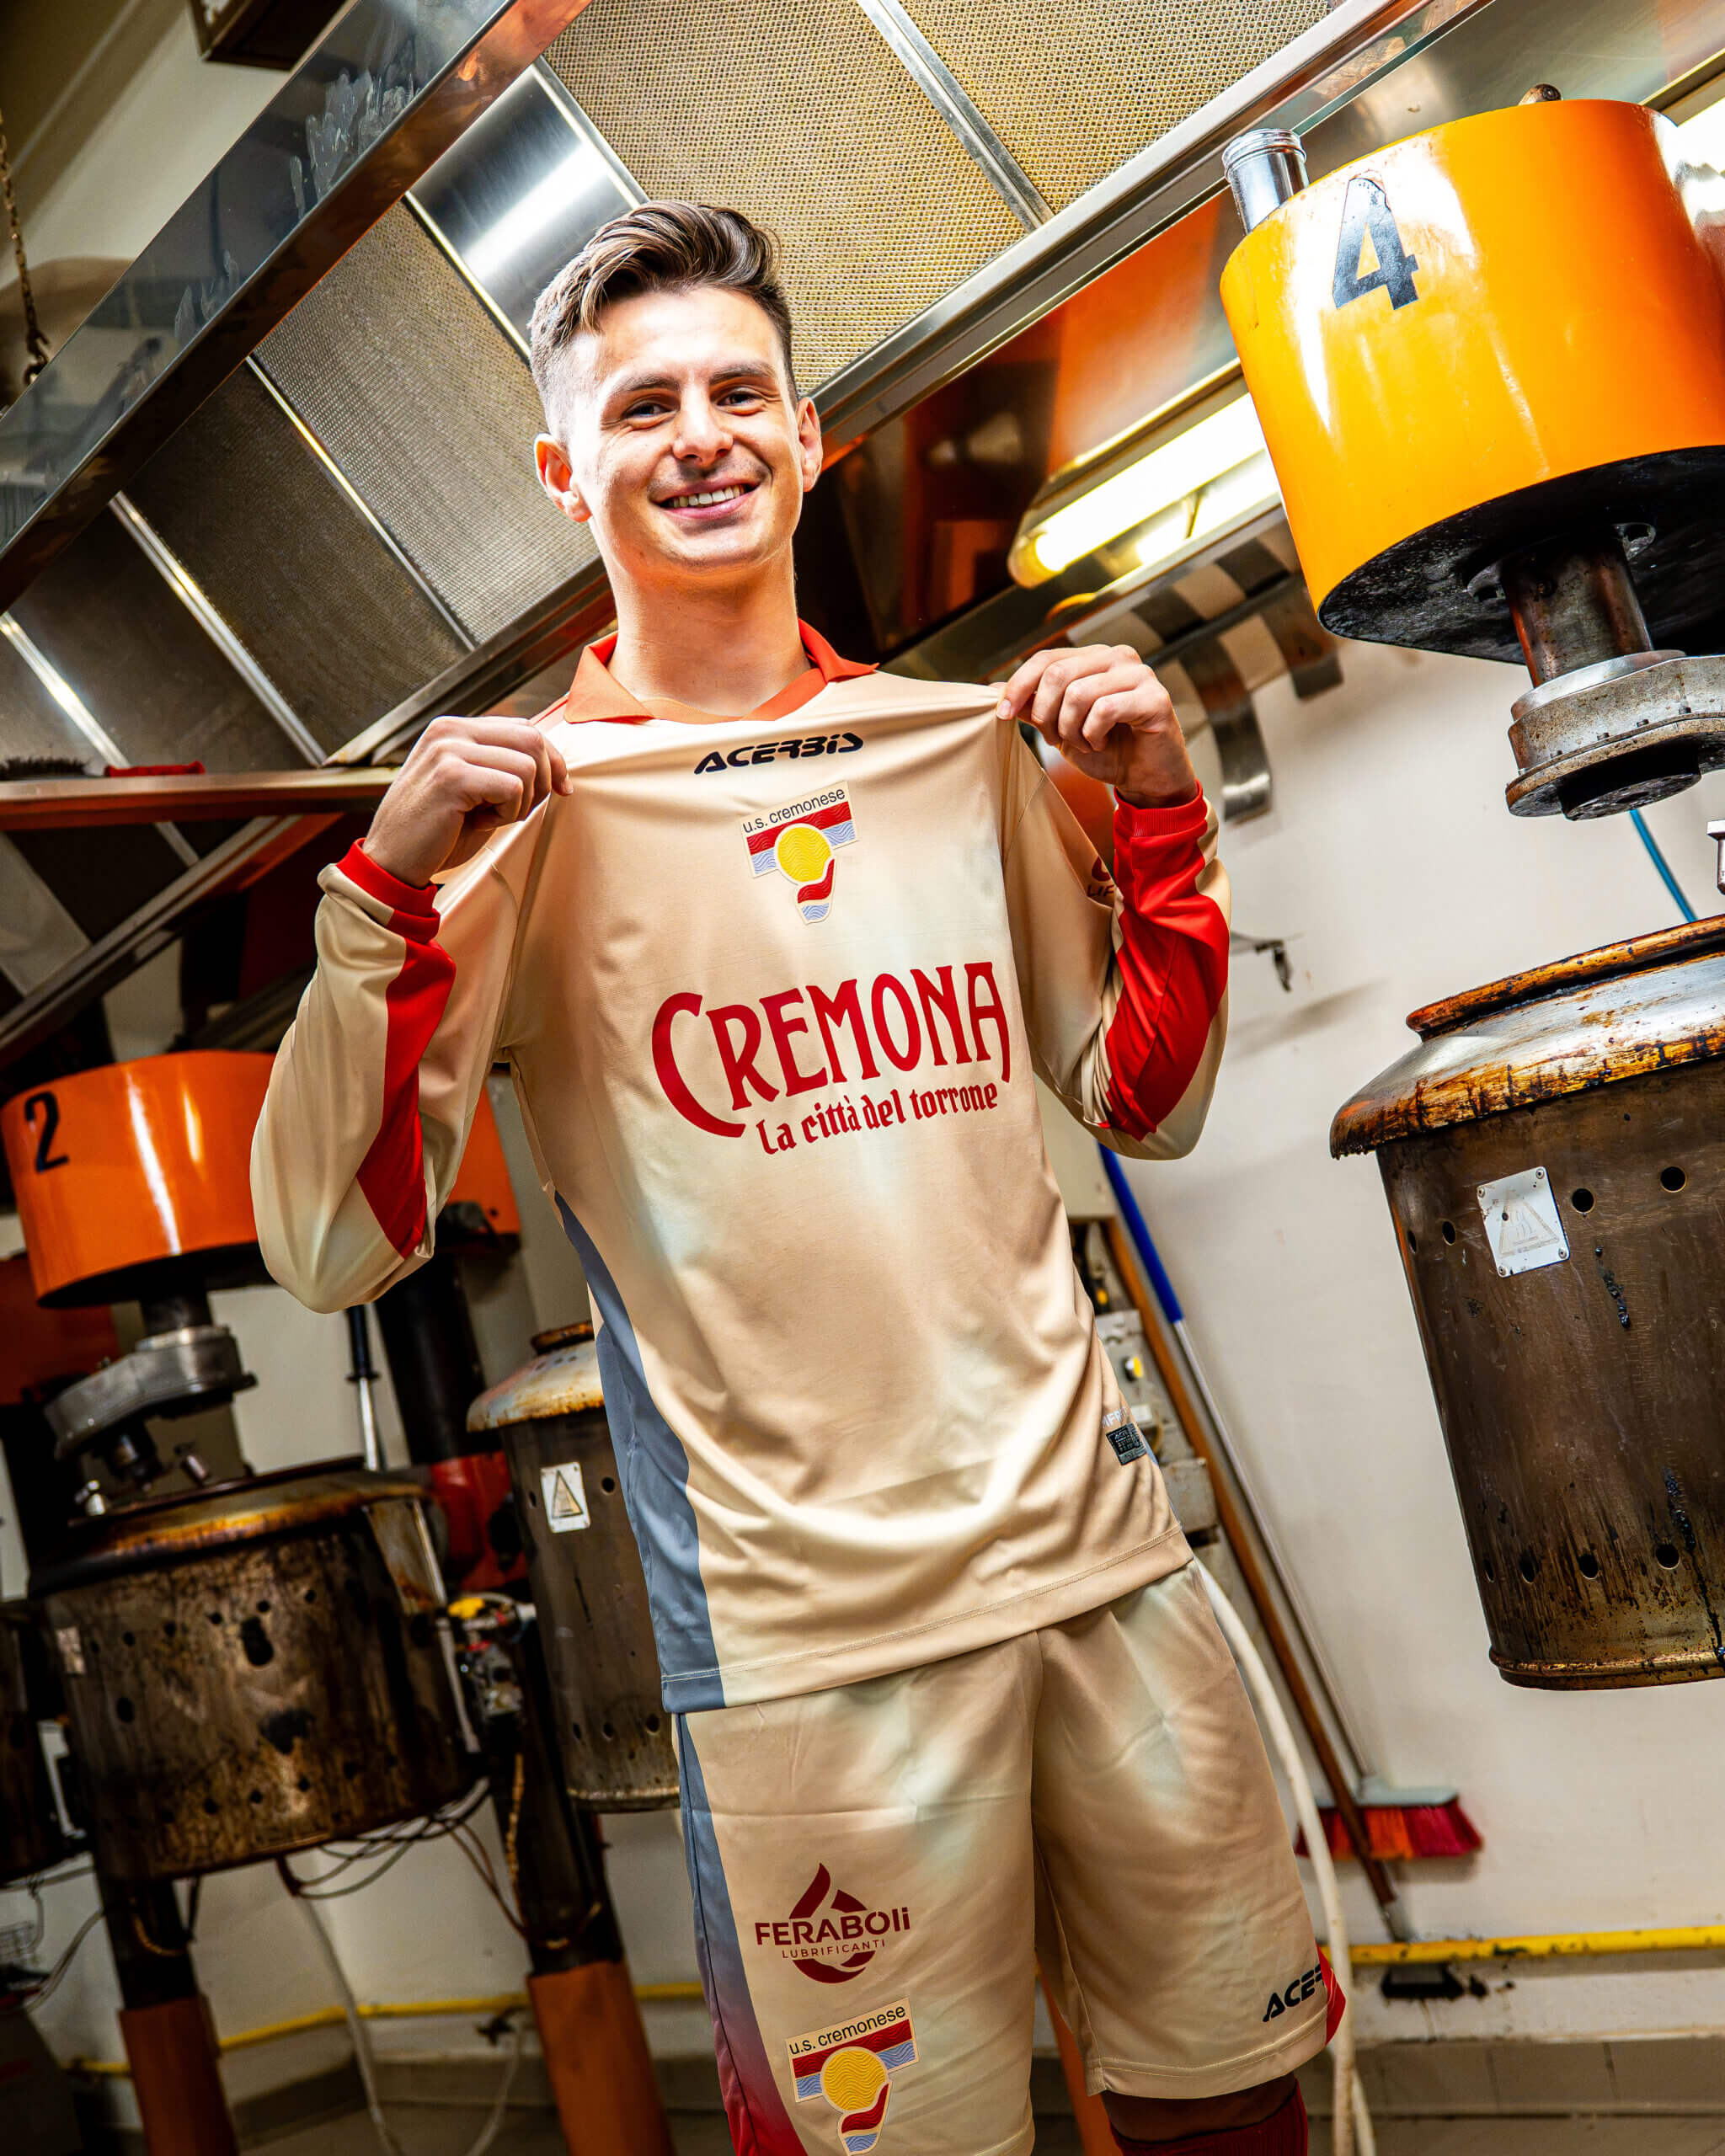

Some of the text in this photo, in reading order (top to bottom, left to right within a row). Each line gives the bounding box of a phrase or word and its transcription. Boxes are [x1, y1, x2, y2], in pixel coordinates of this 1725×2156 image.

[1332, 176, 1419, 311] 4
[742, 787, 846, 834] u.s. cremonese
[651, 961, 1011, 1139] CREMONA
[25, 1091, 68, 1172] 2
[800, 1094, 862, 1144] città
[860, 1088, 907, 1130] del
[909, 1082, 998, 1120] torrone
[782, 1939, 885, 1959] LUBRIFICANTI
[788, 2004, 906, 2055] u.s. cremonese
